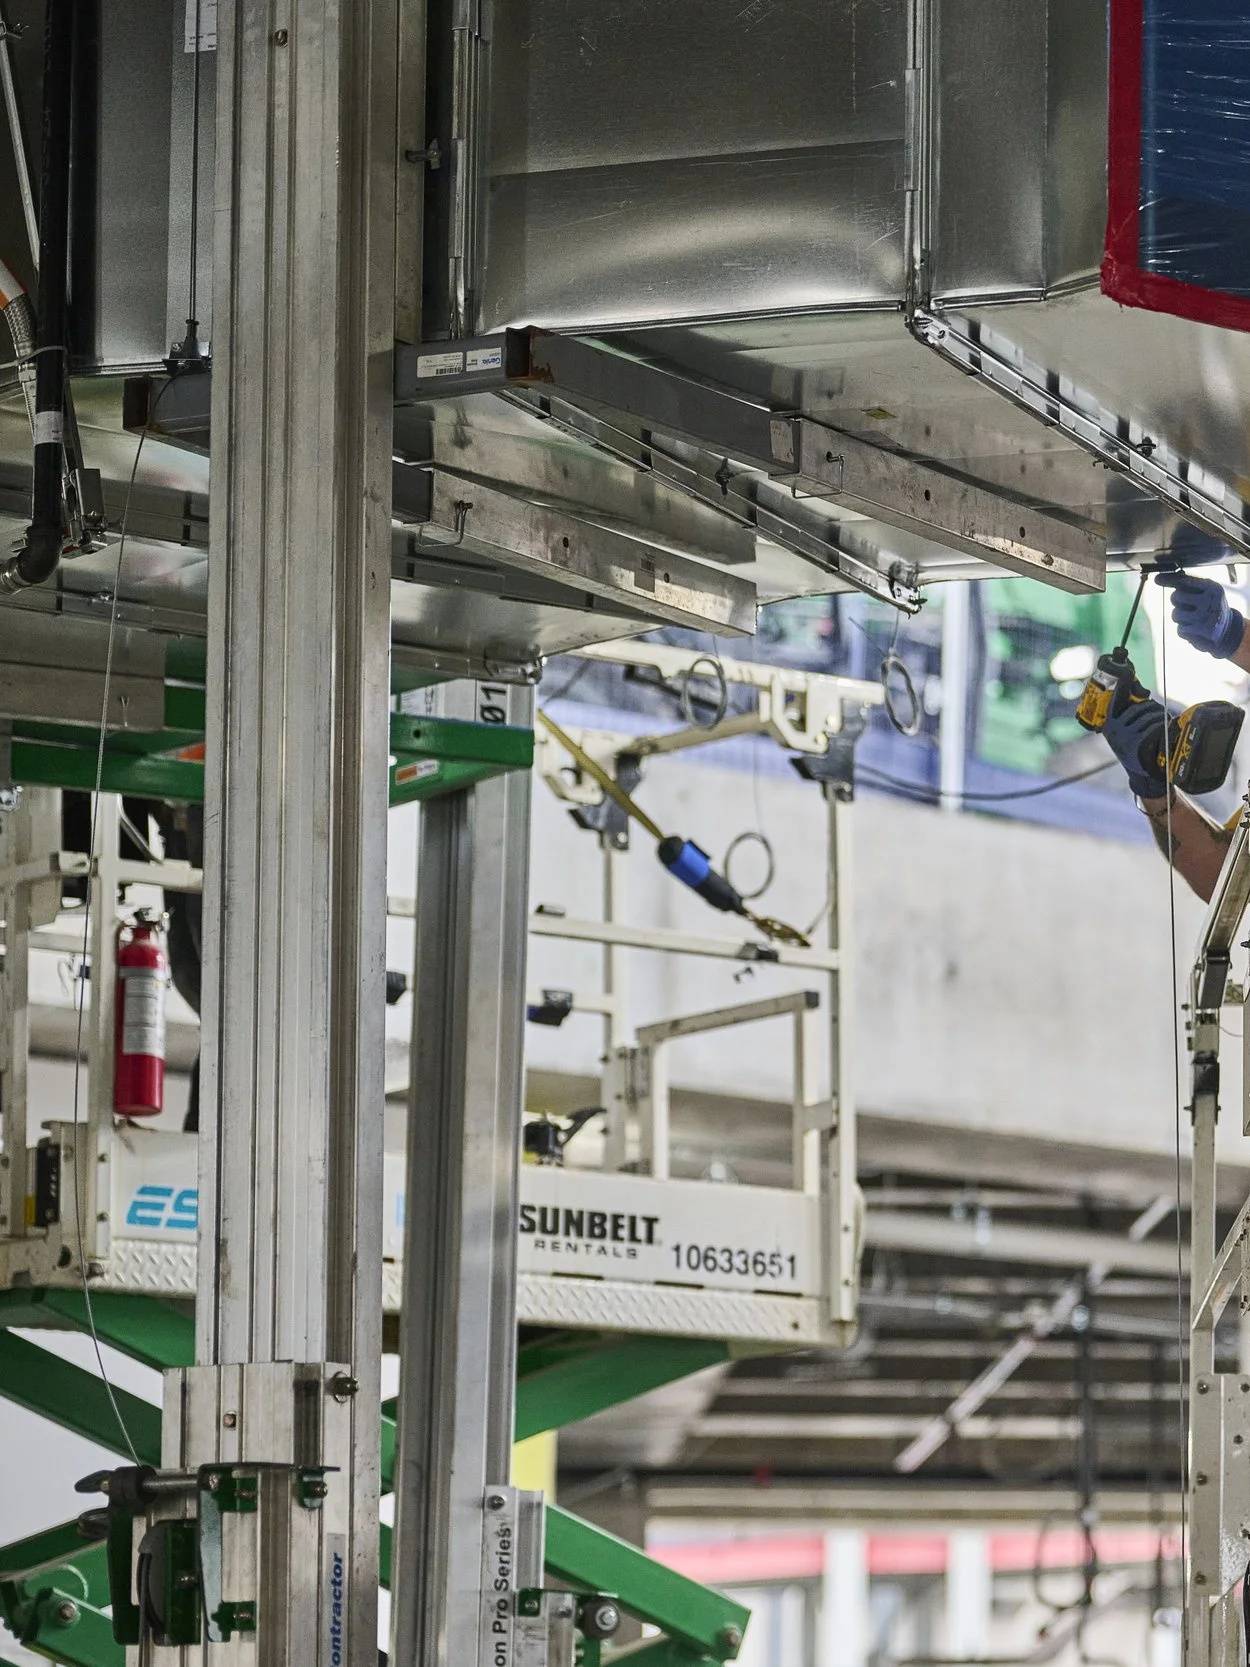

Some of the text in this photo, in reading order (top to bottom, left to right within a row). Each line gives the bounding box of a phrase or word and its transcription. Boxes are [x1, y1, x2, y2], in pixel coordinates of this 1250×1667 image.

[519, 1204, 660, 1246] SUNBELT
[534, 1239, 639, 1260] RENTALS
[671, 1244, 798, 1279] 10633651
[494, 1526, 511, 1592] Series
[329, 1552, 345, 1667] ontractor
[492, 1600, 508, 1635] Pro
